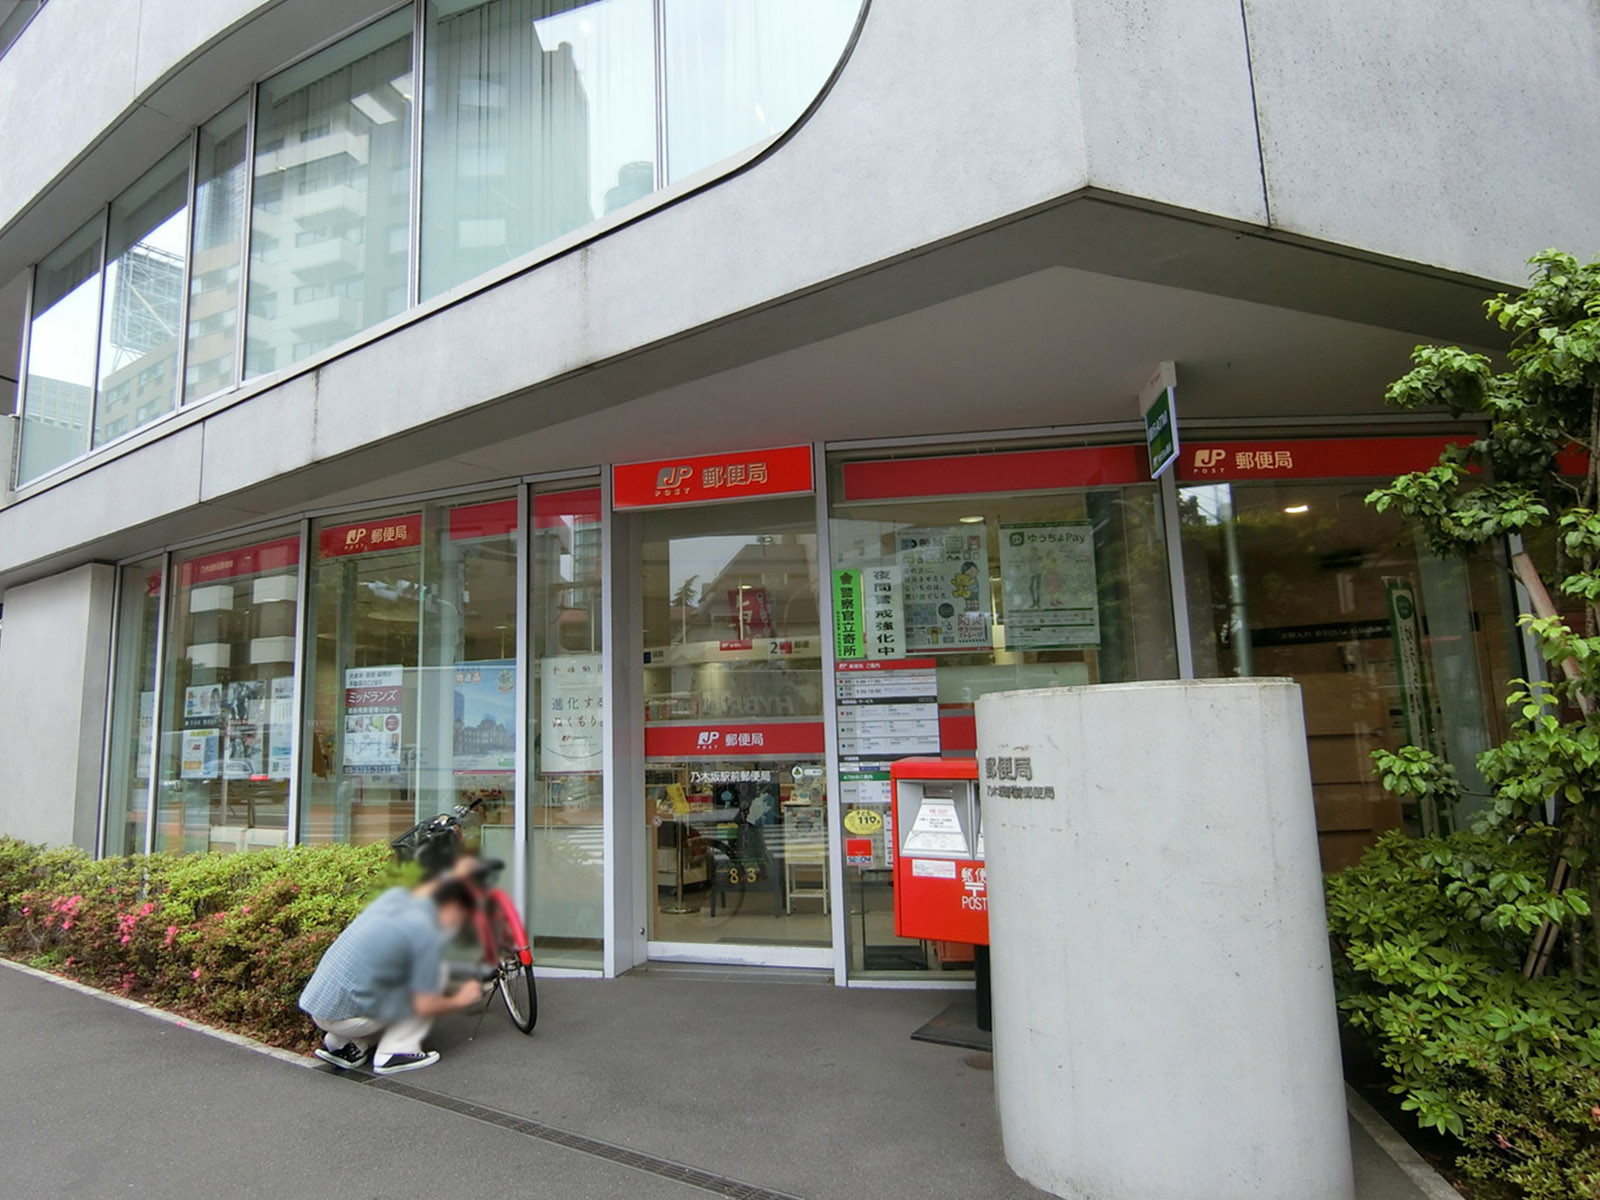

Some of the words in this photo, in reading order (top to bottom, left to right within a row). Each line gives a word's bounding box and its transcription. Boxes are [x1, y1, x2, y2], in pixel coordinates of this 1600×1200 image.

[1194, 450, 1226, 467] JP
[1235, 451, 1293, 470] 郵便局
[657, 466, 693, 489] JP
[702, 462, 768, 488] 郵便局
[655, 487, 691, 496] POST
[346, 528, 366, 545] JP
[371, 525, 407, 543] 郵便局
[840, 587, 856, 656] 警察官立寄所
[873, 570, 895, 656] 夜間警戒強化中
[770, 641, 779, 654] 2
[348, 689, 398, 703] ミッドランズ
[698, 731, 719, 745] JP
[725, 733, 764, 746] 郵便局
[690, 770, 772, 784] 乃木坂駅前郵便局
[985, 756, 1032, 781] 郵便局
[961, 895, 988, 911] POST
